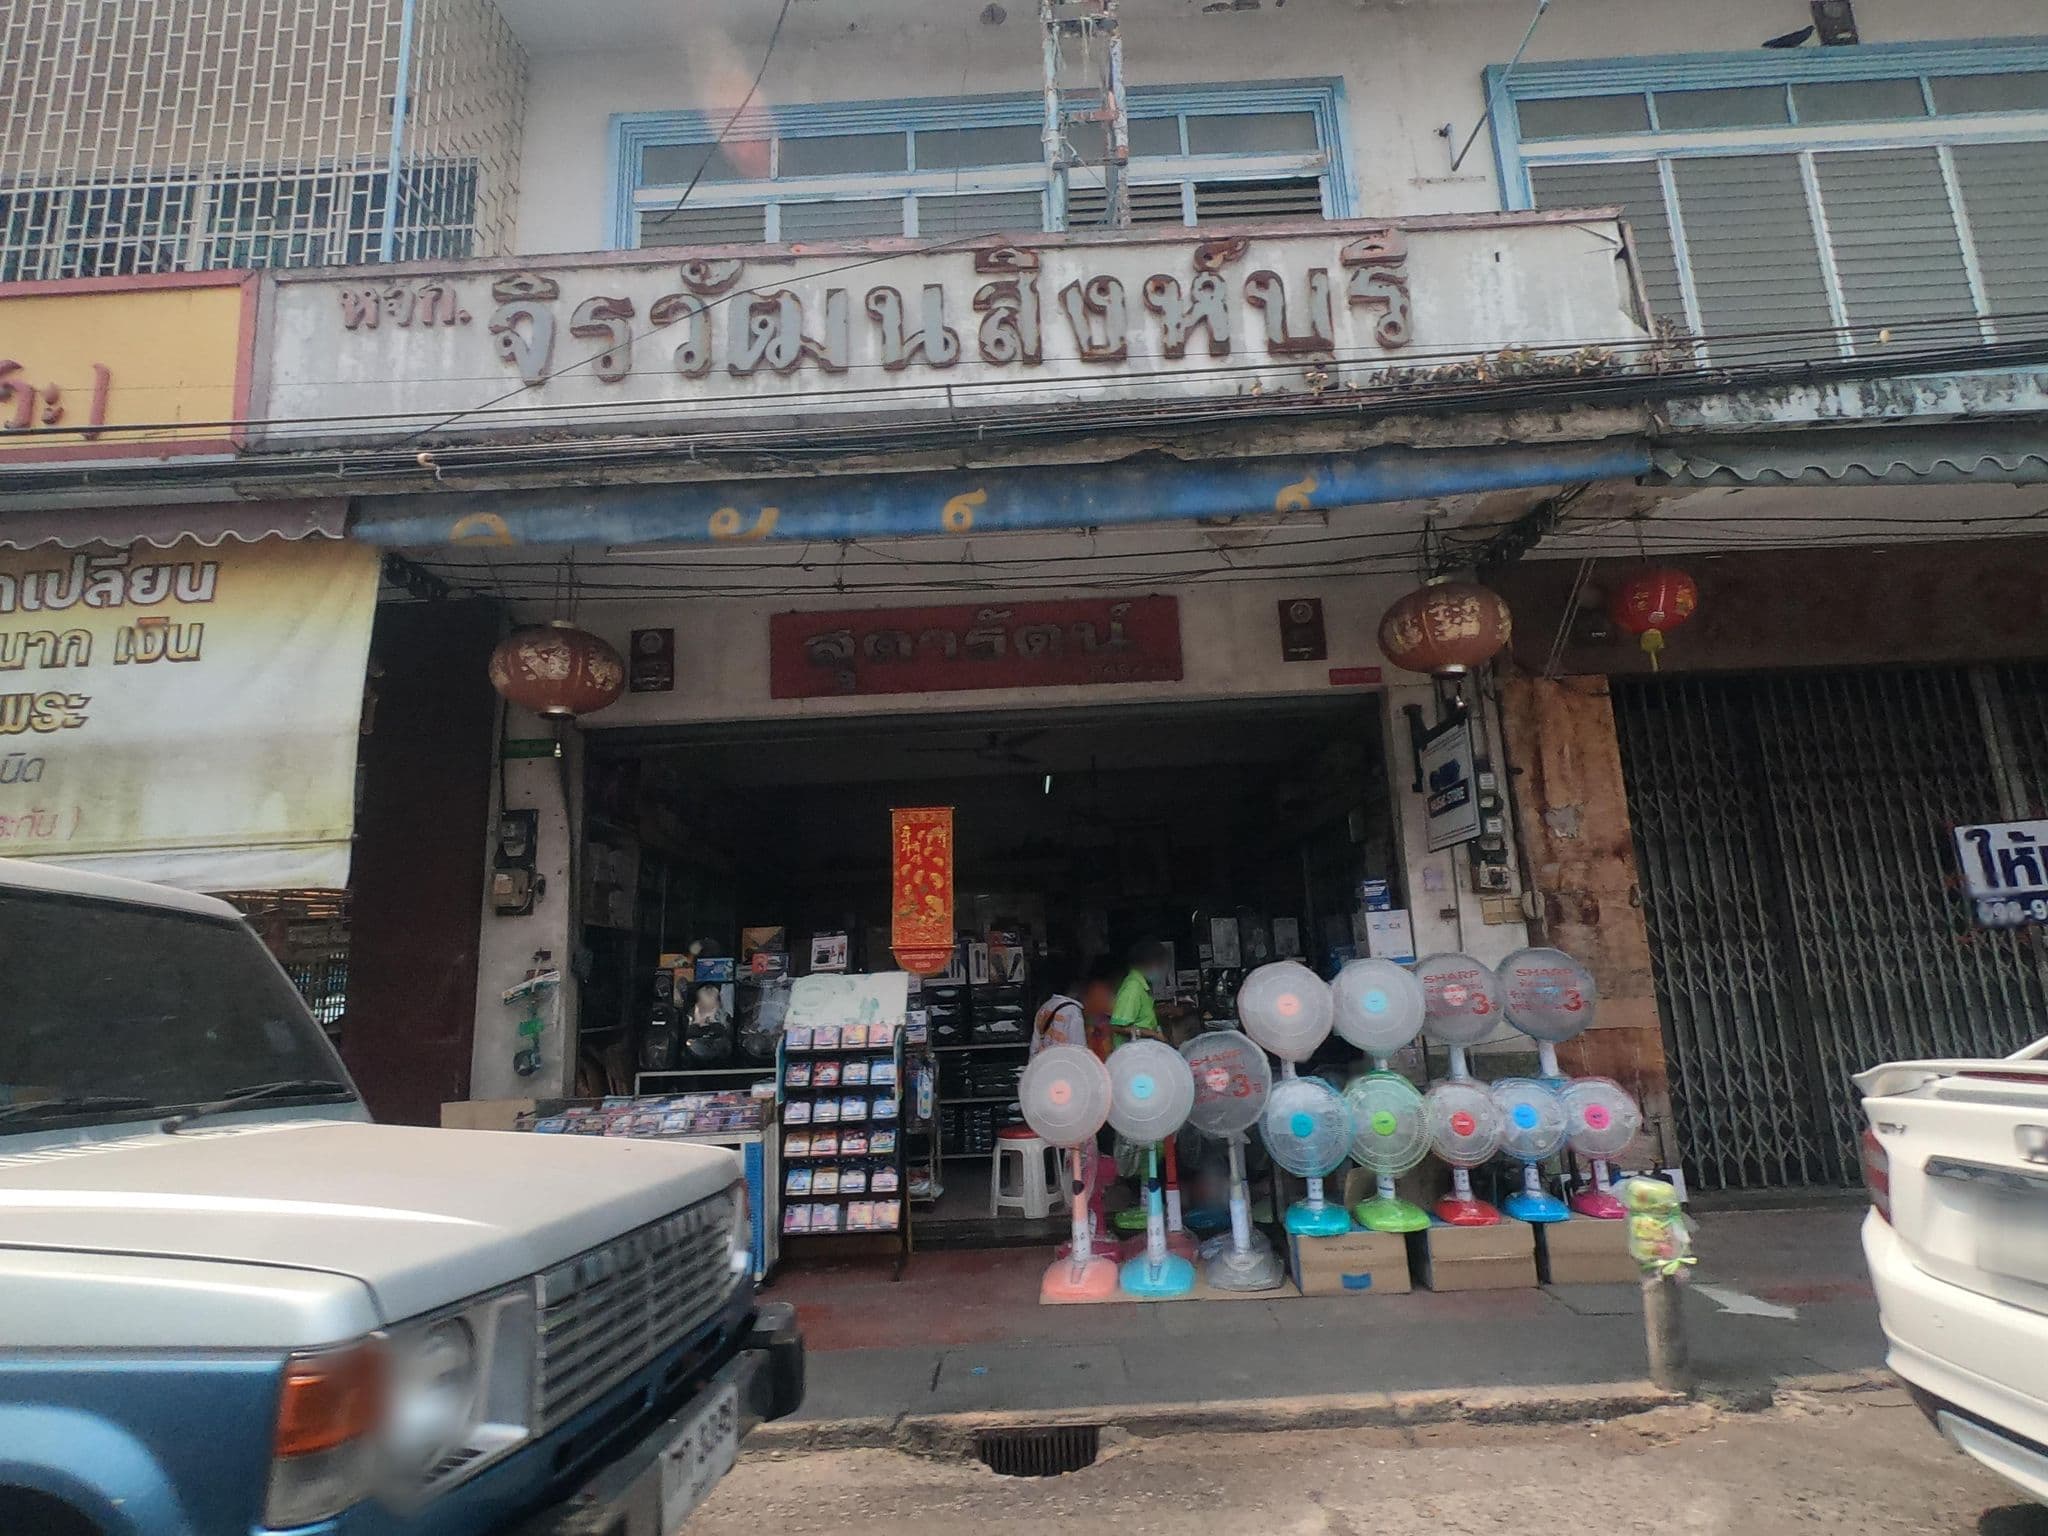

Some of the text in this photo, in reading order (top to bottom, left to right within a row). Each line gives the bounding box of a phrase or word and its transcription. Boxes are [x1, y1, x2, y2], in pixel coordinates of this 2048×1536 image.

[338, 280, 472, 330] หจก.
[1964, 828, 2048, 888] ให้
[1423, 968, 1480, 984] SHARP
[1515, 967, 1574, 977] SHARP
